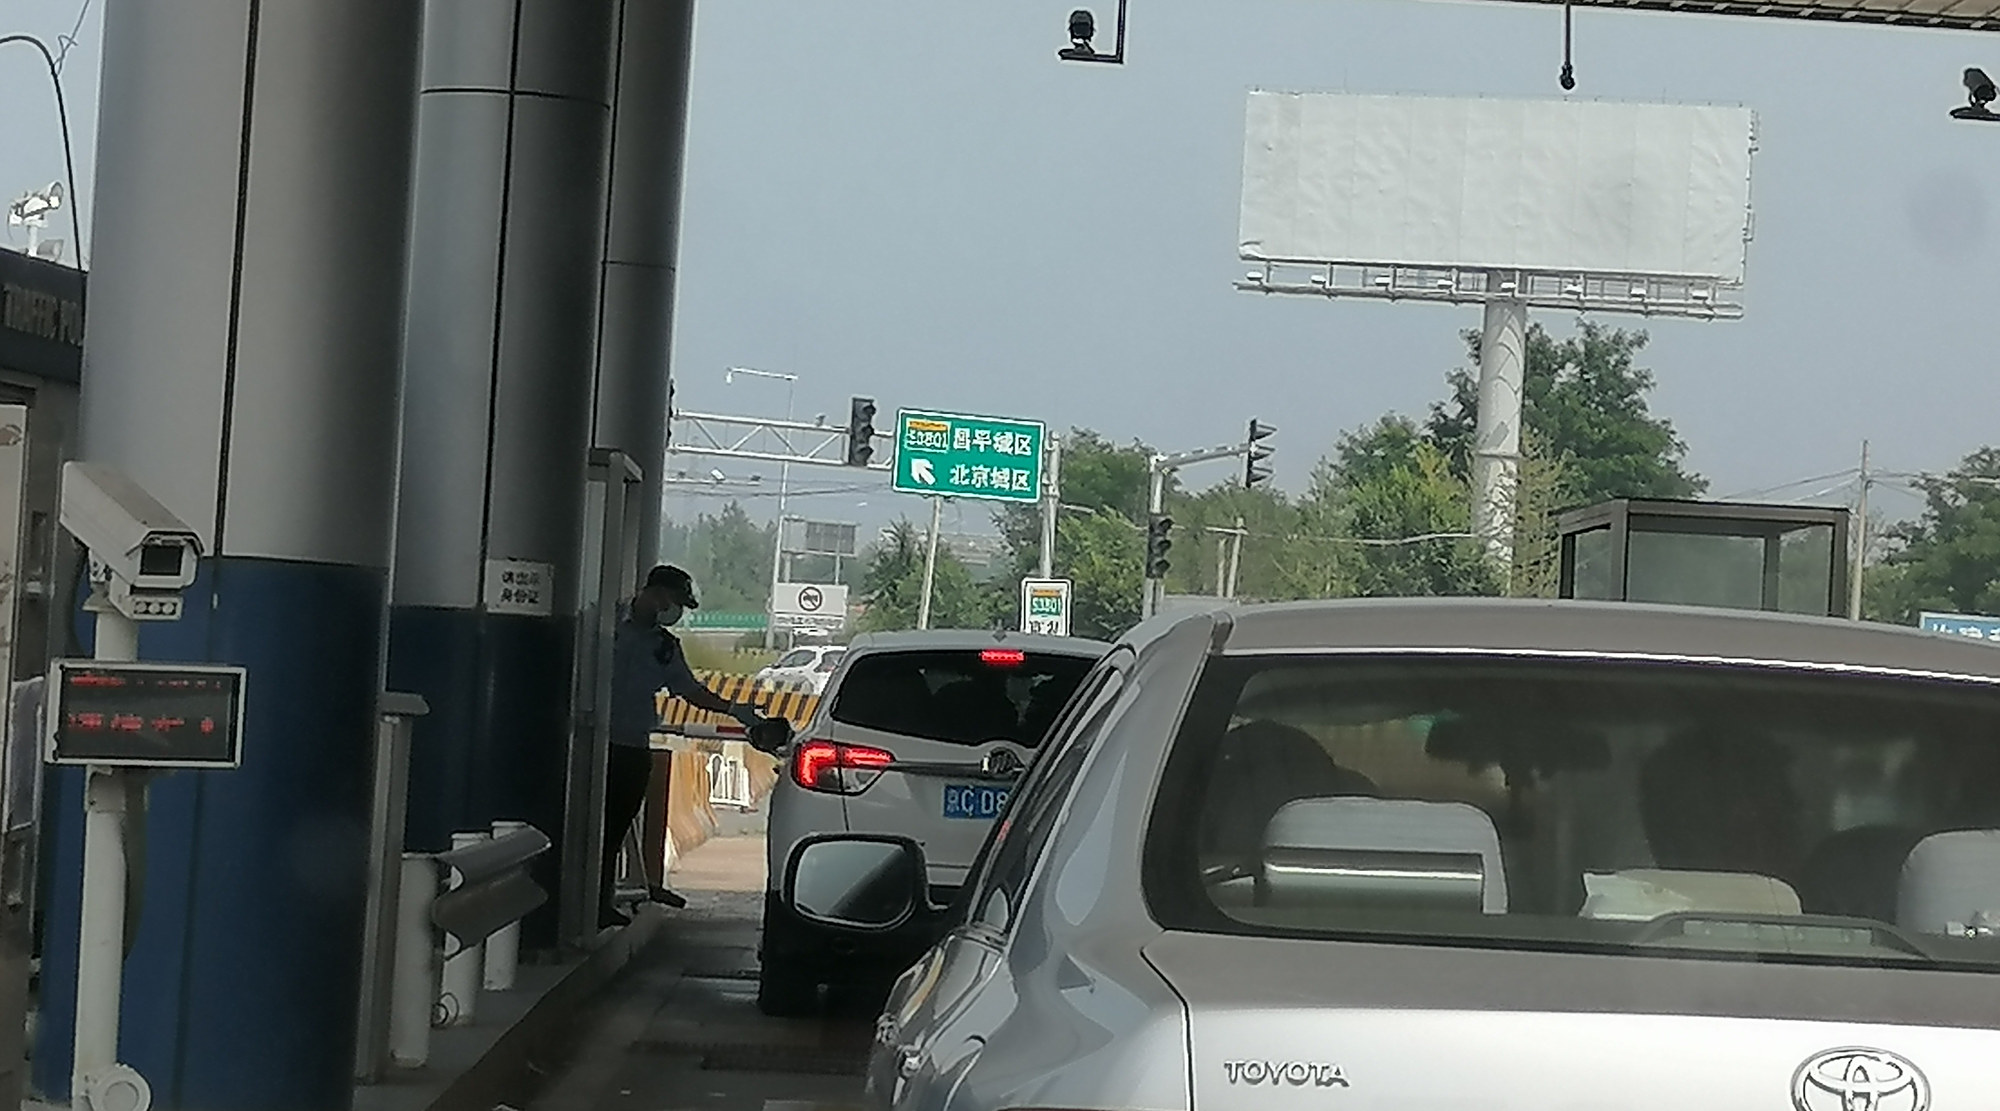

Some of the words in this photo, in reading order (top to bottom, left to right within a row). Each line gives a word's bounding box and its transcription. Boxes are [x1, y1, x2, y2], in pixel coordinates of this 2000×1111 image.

[953, 427, 1032, 456] 昌平城区
[949, 463, 1031, 492] 北京城区
[1224, 1060, 1350, 1088] TOYOTA
